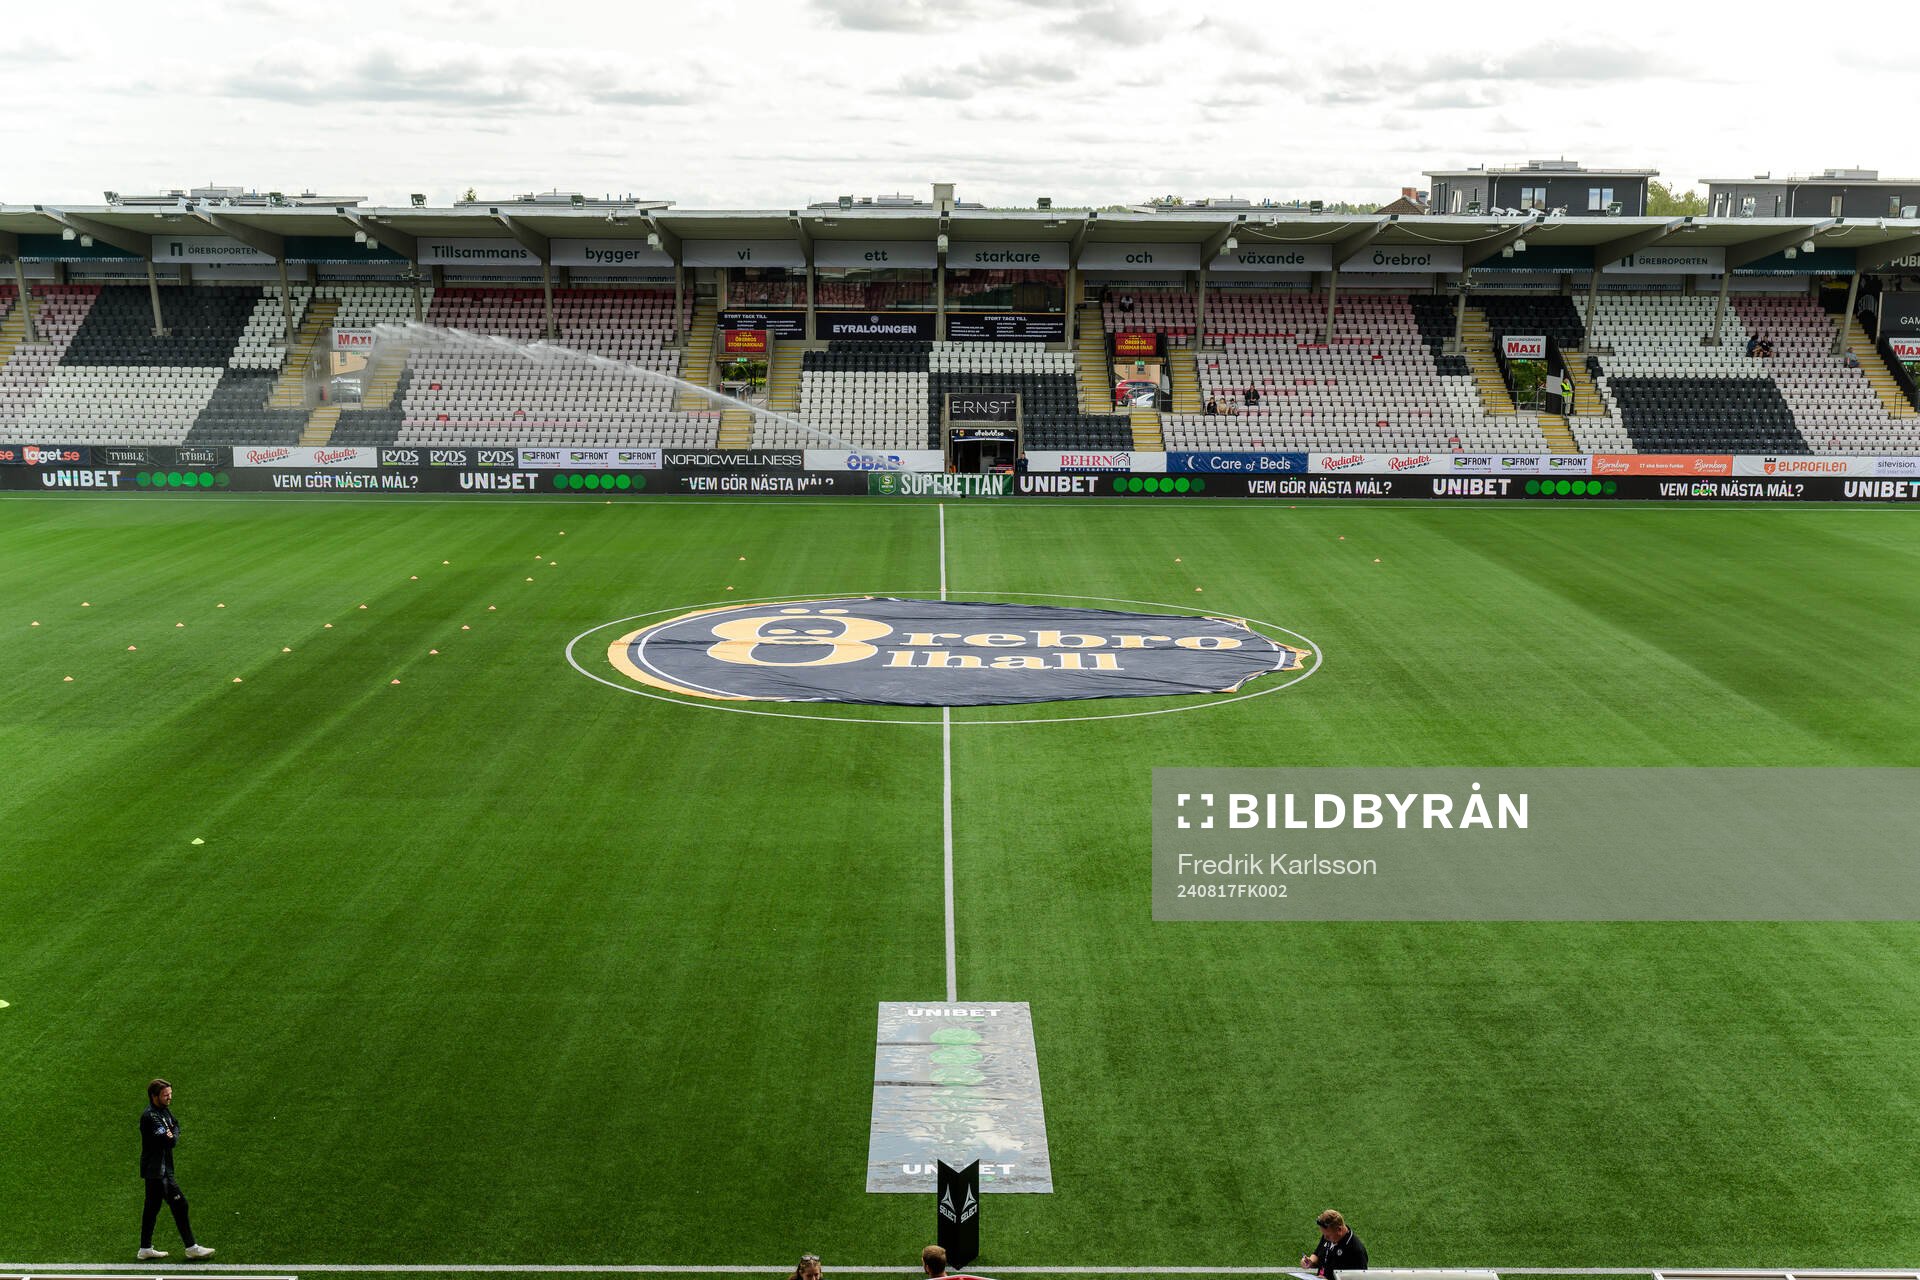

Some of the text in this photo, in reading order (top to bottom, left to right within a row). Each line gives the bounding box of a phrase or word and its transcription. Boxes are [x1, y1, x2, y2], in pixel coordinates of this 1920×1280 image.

[188, 245, 258, 255] ÖREBROPORTEN
[432, 245, 528, 260] Tillsammans
[585, 247, 641, 262] bygger
[737, 248, 751, 261] vi
[864, 250, 888, 262] ett
[975, 250, 1041, 263] starkare
[1126, 251, 1153, 264] och
[1238, 251, 1305, 265] växande
[1373, 248, 1432, 266] Örebro!
[1639, 255, 1708, 265] ÖREBROPORTEN
[832, 324, 917, 334] EYRALOUNGEN
[952, 400, 1011, 414] ERNST
[25, 448, 80, 462] laget.se
[109, 451, 145, 462] TYBBLE
[179, 452, 214, 462] TYBBLE
[382, 450, 419, 462] RYDS
[430, 450, 467, 462] RYDS
[477, 450, 515, 463] RYDS
[535, 451, 561, 460] FRONT
[584, 452, 609, 460] FRONT
[632, 452, 657, 460] FRONT
[1060, 454, 1113, 466] BEHRN
[1467, 457, 1492, 466] FRONT
[1515, 457, 1540, 466] FRONT
[1563, 457, 1588, 466] FRONT
[1210, 456, 1291, 471] Care of Beds
[42, 470, 121, 487] UNIBET
[272, 471, 419, 489] VEM GÖR NÄSTA MÅL?
[459, 472, 539, 490] UNIBET
[689, 477, 717, 491] VEM
[721, 474, 748, 491] GÖR
[751, 474, 794, 491] NÄSTA
[901, 473, 1004, 495] SUPERETTAN
[1019, 475, 1099, 493] UNIBET
[1247, 477, 1393, 494] VEM GÖR NÄSTA MÅL?
[1432, 478, 1512, 496] UNIBET
[1659, 479, 1804, 497] VEM GÖR NÄSTA MÅL?
[1843, 480, 1920, 498] UNIBET
[907, 1008, 1001, 1017] UNIBET
[902, 1163, 1016, 1175] UNET
[939, 1204, 957, 1224] SELECT
[960, 1203, 978, 1224] SELECT
